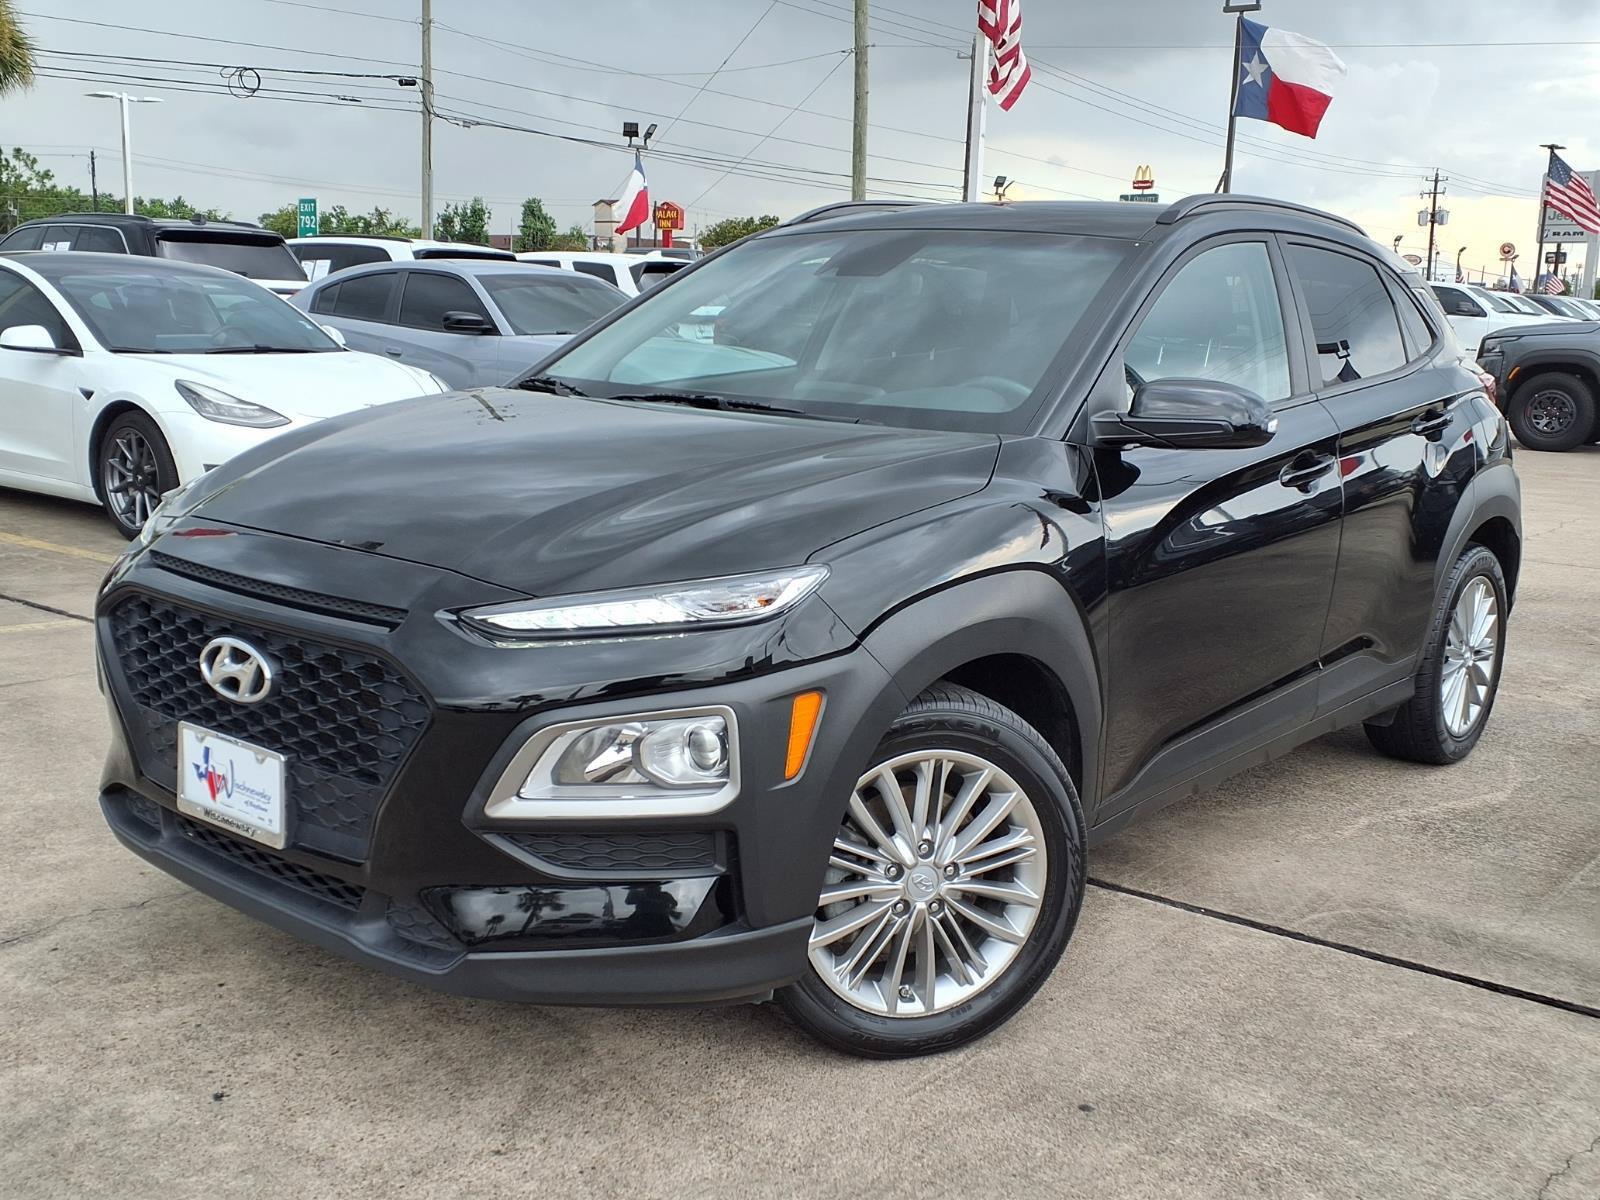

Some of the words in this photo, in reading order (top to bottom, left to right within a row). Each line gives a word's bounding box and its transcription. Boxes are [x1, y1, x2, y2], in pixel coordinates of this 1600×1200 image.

[300, 203, 315, 212] EXIT
[1548, 210, 1574, 222] Jee
[300, 216, 316, 228] 792
[659, 219, 672, 228] INN
